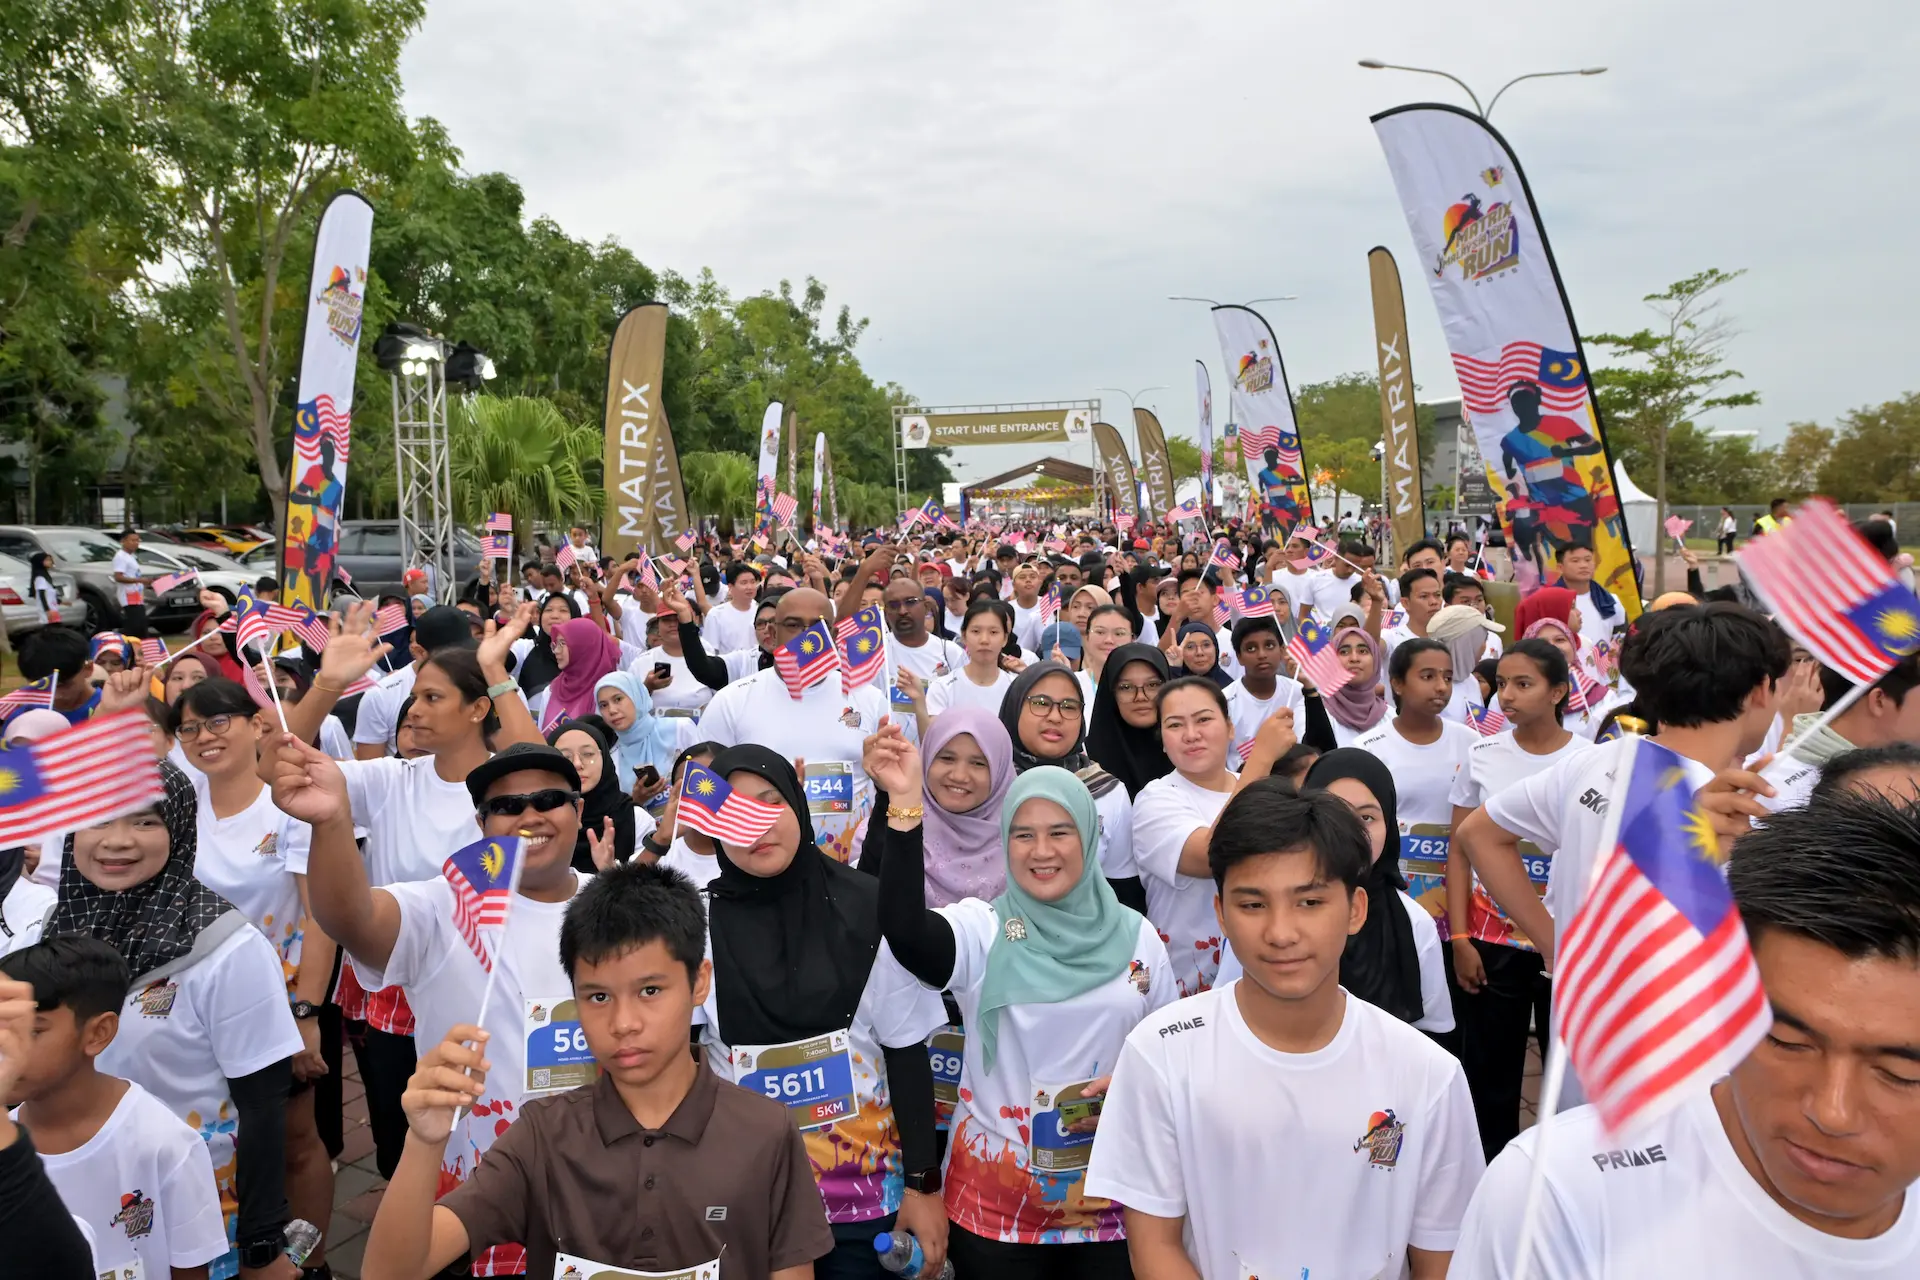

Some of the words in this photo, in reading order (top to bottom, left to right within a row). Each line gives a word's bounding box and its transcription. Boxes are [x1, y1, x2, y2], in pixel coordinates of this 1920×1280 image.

[1455, 200, 1513, 247] MATRIX
[1463, 228, 1514, 281] RUN
[327, 308, 358, 335] RUN
[935, 426, 970, 436] START
[972, 424, 997, 434] LINE
[1000, 422, 1059, 433] ENTRANCE
[1381, 331, 1413, 515] MATRIX
[618, 379, 650, 537] MATRIX
[803, 778, 844, 794] 7544
[834, 802, 848, 810] 5KM
[139, 998, 172, 1014] RUN
[1158, 1016, 1205, 1039] PRIME
[805, 1048, 828, 1058] 7:40am
[764, 1066, 825, 1098] 5611
[816, 1101, 844, 1117] 5KM
[1592, 1144, 1667, 1173] PRIME
